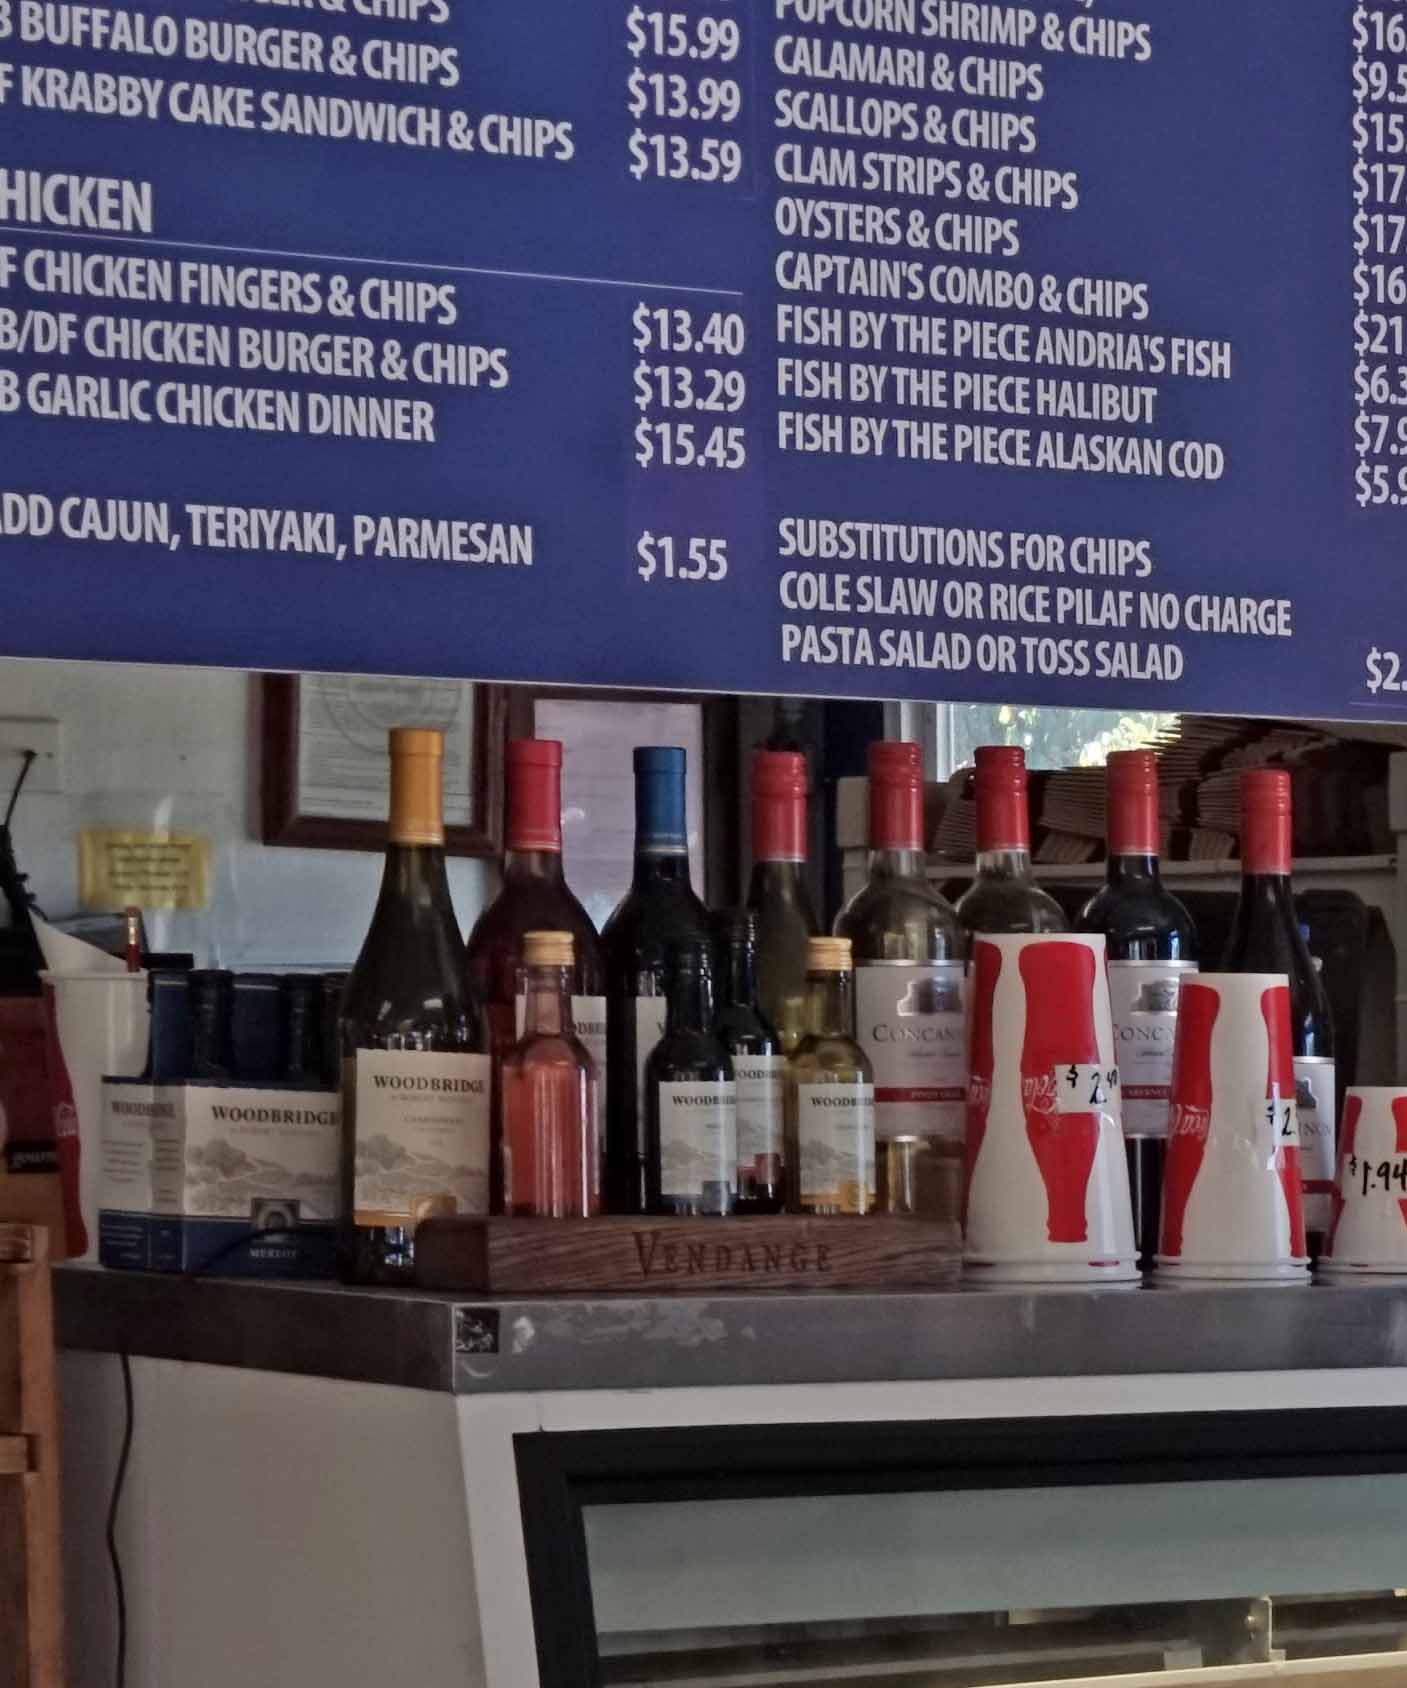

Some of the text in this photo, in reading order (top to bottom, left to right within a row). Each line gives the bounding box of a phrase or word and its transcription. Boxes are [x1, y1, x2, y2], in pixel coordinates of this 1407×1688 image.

[20, 0, 460, 87] BUFFALO BURGER & CHIPS
[626, 4, 740, 62] $15.99
[627, 66, 741, 123] $13.99
[774, 34, 1044, 102] CALAMARI & CHIPS
[21, 65, 575, 161] KRABBY CAKE SANDWICH & CHIPS
[774, 143, 1079, 210] CLAM STRIPS & CHIPS
[23, 248, 457, 326] CHICKEN FINGERS & CHIPS
[775, 250, 1149, 321] CAPTAIN'S COMBO & CHIPS
[632, 301, 745, 356] $13.40
[26, 372, 436, 443] GARLIC CHICKEN DINNER
[777, 357, 1158, 424] FISH BY THE PIECE HALIBUT
[634, 416, 746, 469] $15.45
[59, 496, 533, 566] CAJUN, TERIYAKI, PARMESAN
[637, 530, 728, 582] $1.55
[778, 517, 1152, 578] SUBSTITUTIONS FOR CHIPS
[781, 623, 1184, 681] PASTA SALAD OR TOSS SALAD
[374, 1075, 485, 1094] WOODBRIDGE
[212, 1104, 340, 1127] WOODBRIDGE
[632, 1231, 832, 1279] VENDANGE
